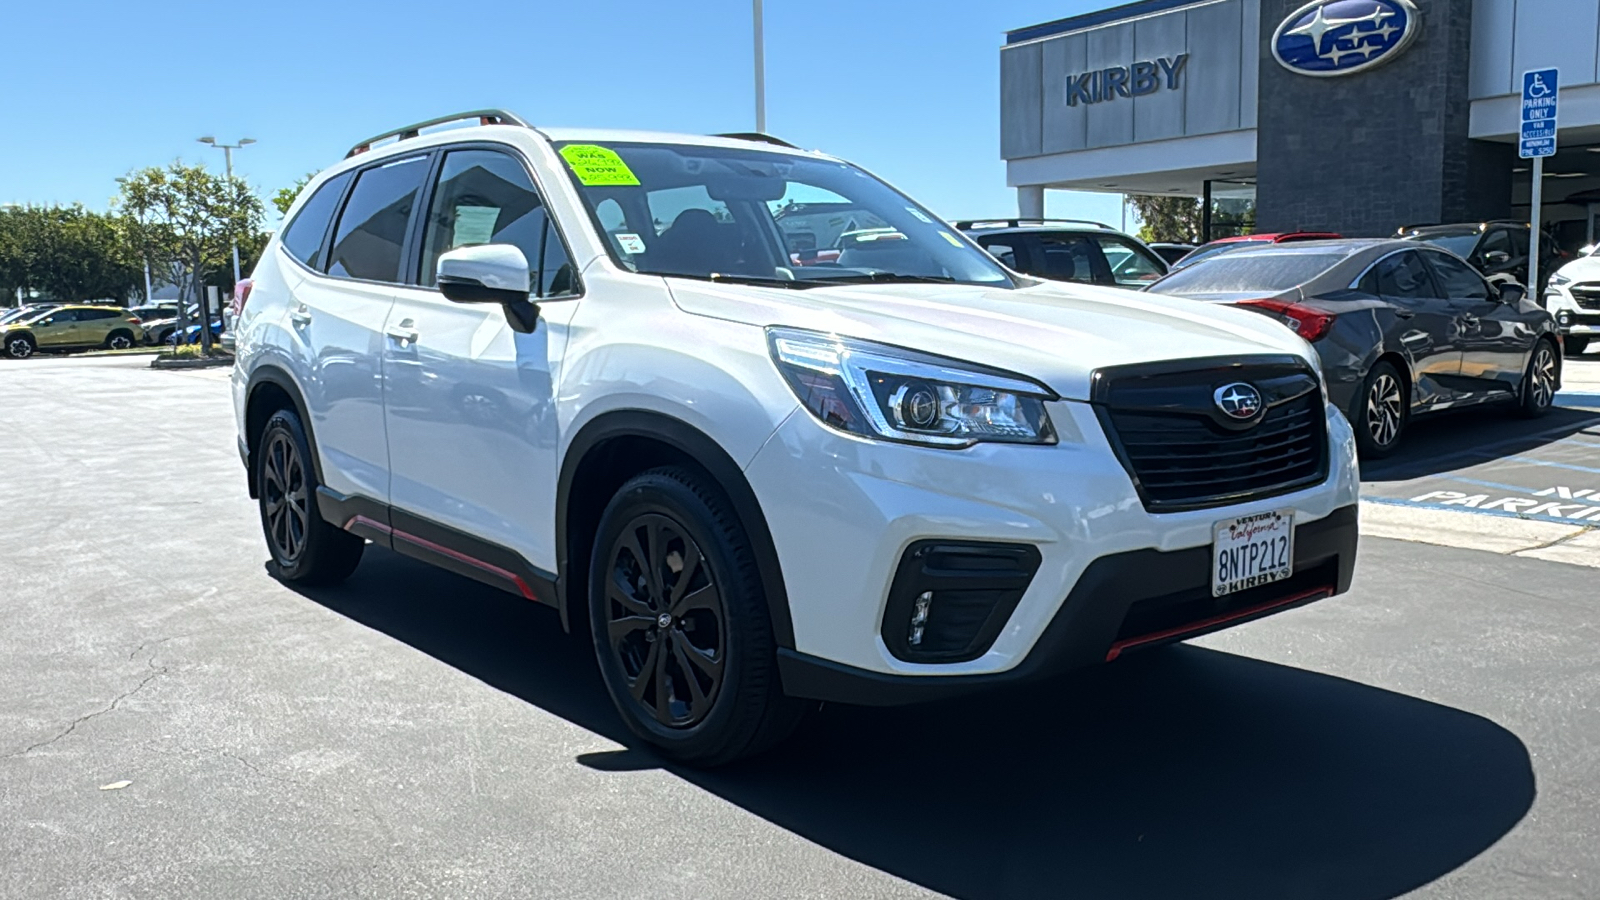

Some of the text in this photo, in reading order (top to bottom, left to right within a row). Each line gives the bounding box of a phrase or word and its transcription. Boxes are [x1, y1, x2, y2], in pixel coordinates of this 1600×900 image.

[1066, 53, 1189, 107] KIRBY
[1524, 96, 1556, 109] PARKING
[1529, 108, 1549, 120] ONLY
[1533, 121, 1545, 129] VAN
[1236, 511, 1277, 525] VENTURA
[1230, 522, 1279, 541] California
[1219, 536, 1287, 583] 8NTP212
[1229, 571, 1279, 592] KIRBY
